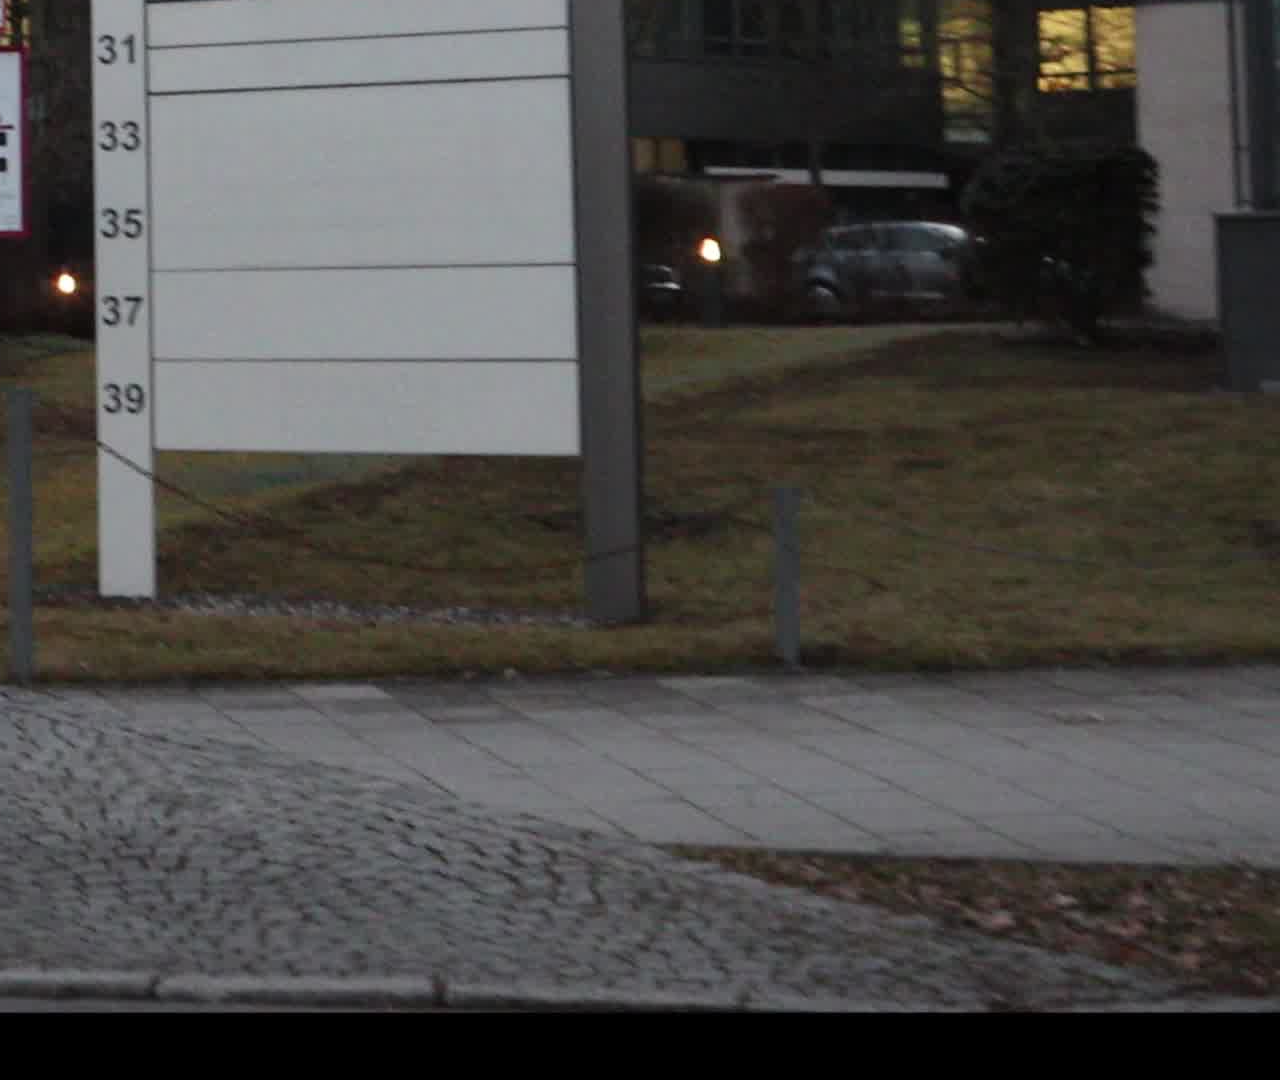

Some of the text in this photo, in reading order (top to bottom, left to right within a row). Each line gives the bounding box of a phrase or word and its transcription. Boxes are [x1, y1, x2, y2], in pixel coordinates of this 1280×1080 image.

[97, 34, 137, 65] 31
[99, 121, 141, 152] 33
[100, 209, 143, 239] 35
[101, 296, 143, 326] 37
[103, 383, 144, 415] 39
